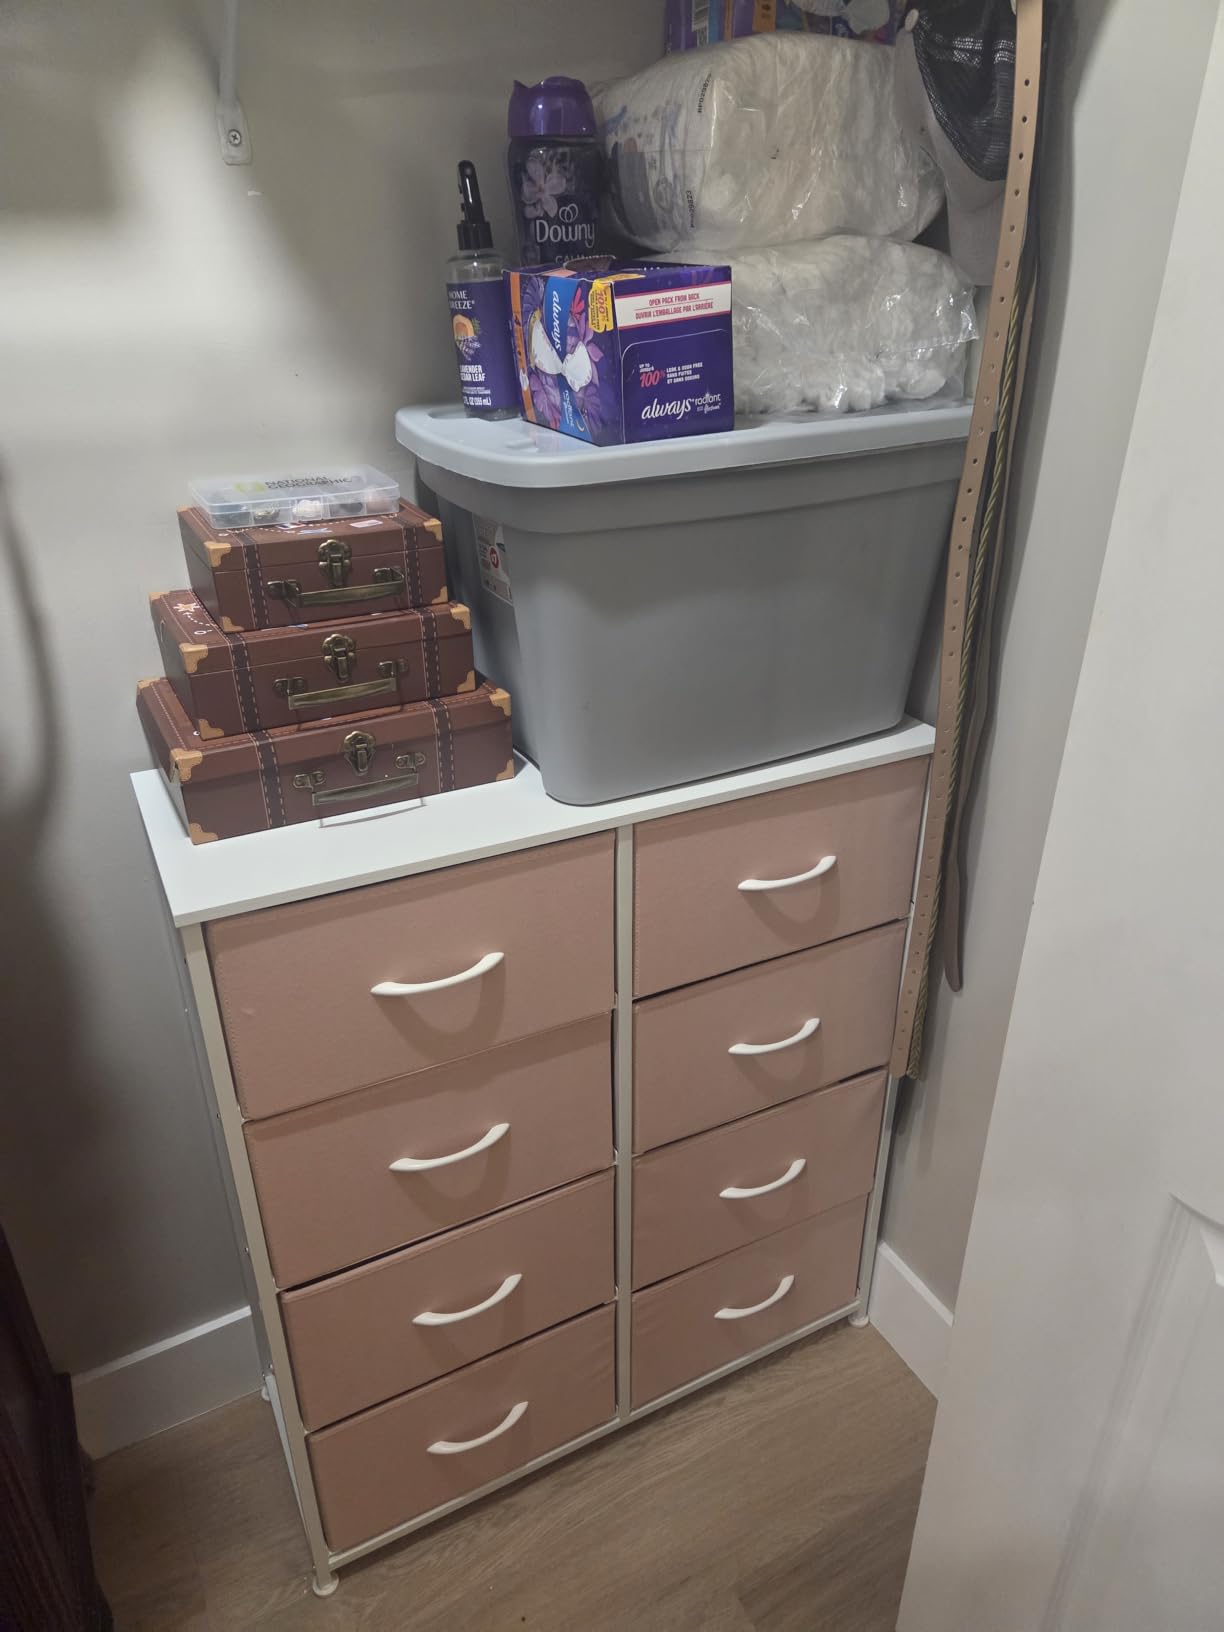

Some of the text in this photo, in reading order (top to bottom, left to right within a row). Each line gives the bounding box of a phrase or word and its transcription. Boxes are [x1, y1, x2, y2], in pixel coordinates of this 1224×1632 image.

[535, 219, 595, 248] Downy
[648, 292, 700, 307] OPEN PACK FROM BACK
[552, 290, 562, 352] always
[472, 372, 486, 382] LEAF
[641, 397, 692, 420] always
[265, 476, 329, 486] NATIONAL
[267, 478, 353, 489] GEOGRAPHIC
